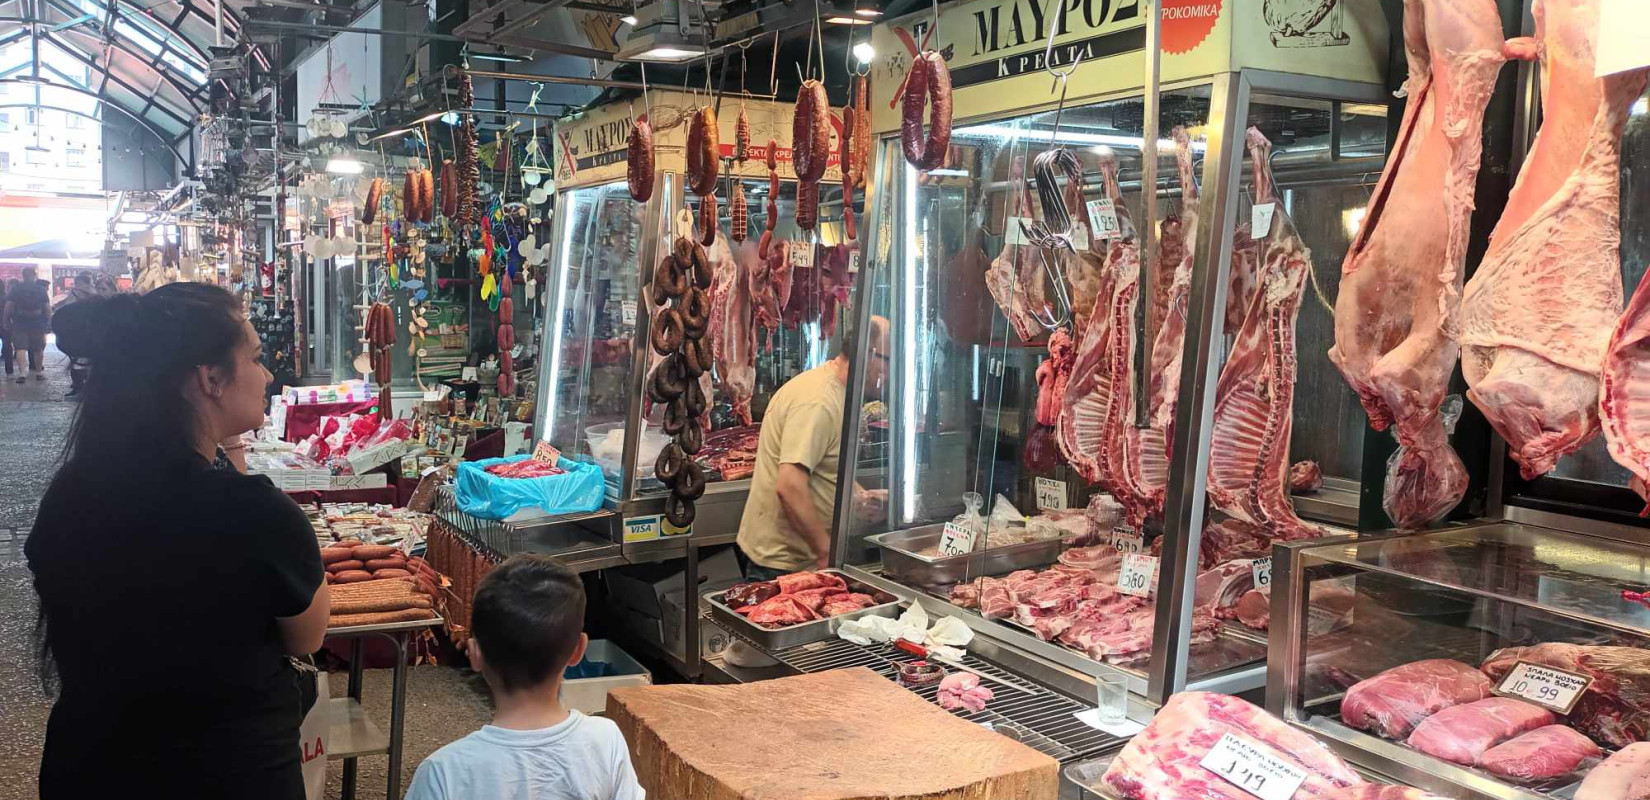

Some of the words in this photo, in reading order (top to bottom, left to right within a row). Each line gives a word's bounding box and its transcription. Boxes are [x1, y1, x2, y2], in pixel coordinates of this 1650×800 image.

[997, 42, 1095, 77] ΚΡΕΑΤΑ
[631, 524, 652, 534] VISA
[1537, 686, 1560, 701] 99
